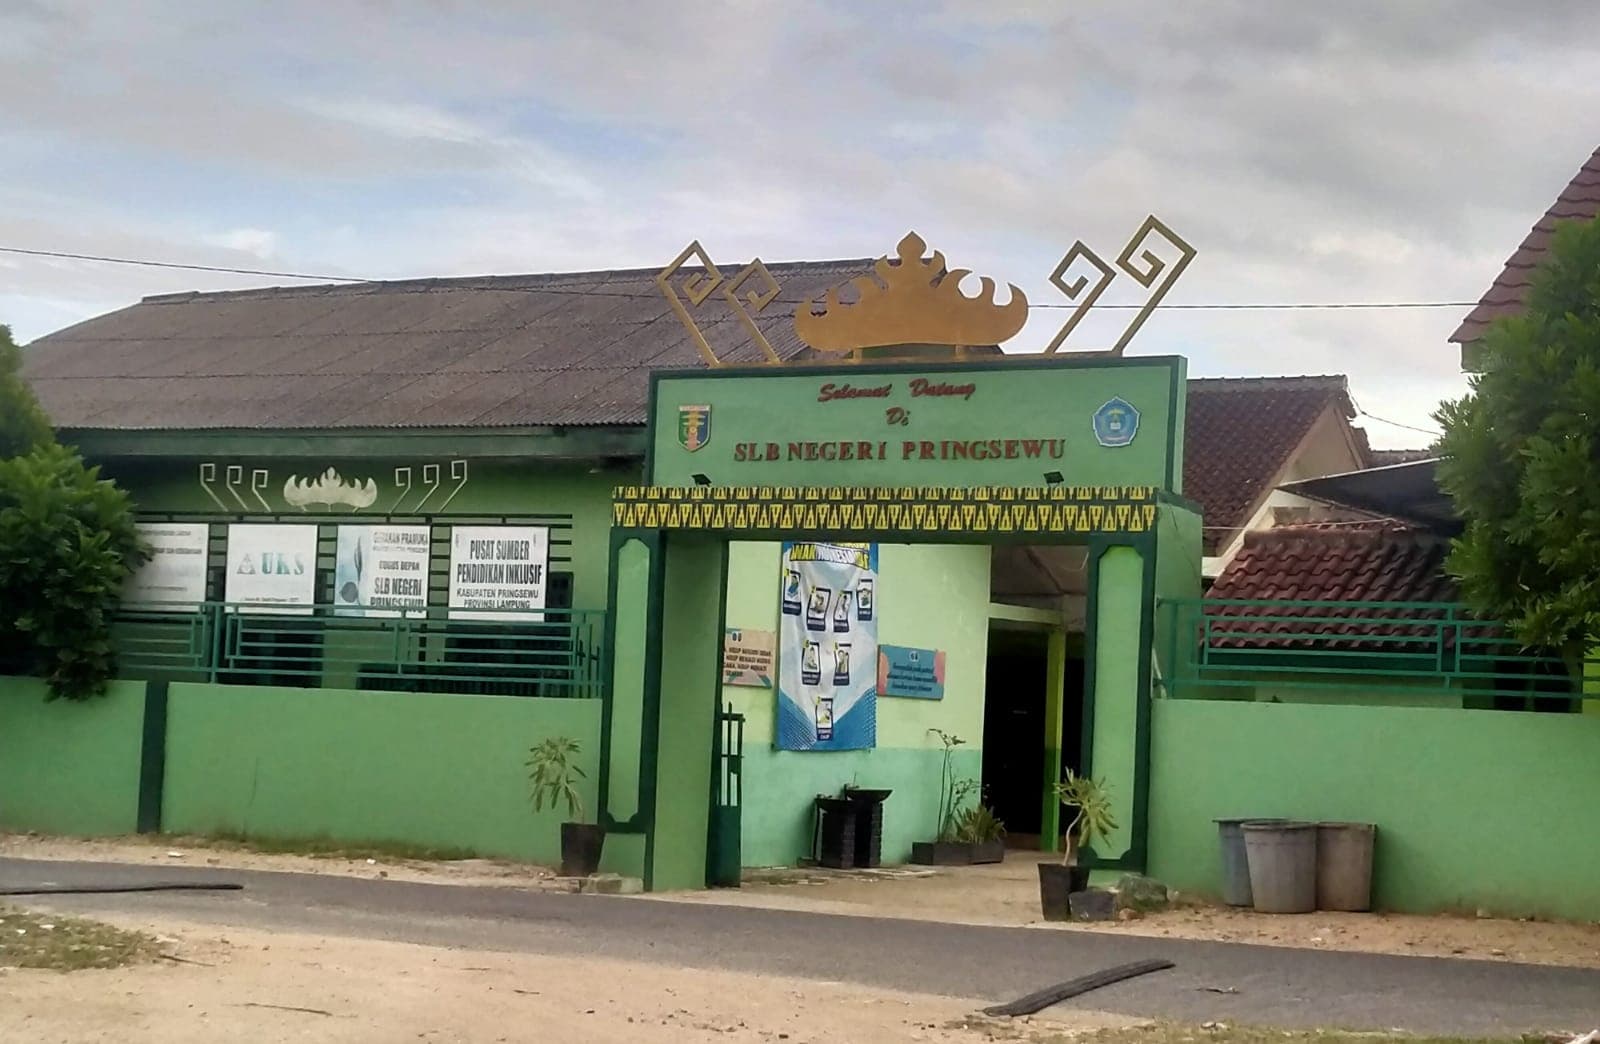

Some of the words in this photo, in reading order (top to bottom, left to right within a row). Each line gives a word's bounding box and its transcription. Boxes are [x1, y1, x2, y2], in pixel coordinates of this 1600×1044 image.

[817, 383, 892, 402] Selamat
[908, 378, 976, 400] Datang
[886, 406, 911, 426] Di
[733, 442, 781, 462] SLB
[787, 441, 888, 461] NEGERI
[902, 439, 1066, 461] PRINGSEWU
[470, 540, 495, 560] PUSAT
[496, 540, 530, 560] SUMBER
[261, 552, 305, 576] UKS
[457, 563, 504, 584] PENDIDIKAN
[505, 563, 542, 585] INKLUSIF
[374, 577, 390, 594] SLB
[392, 578, 422, 596] NEGERI
[457, 587, 495, 598] KABUPATEN
[497, 588, 539, 599] PRINGSEWU
[464, 599, 495, 609] PROVINSI
[497, 599, 530, 609] LAMPUNG
